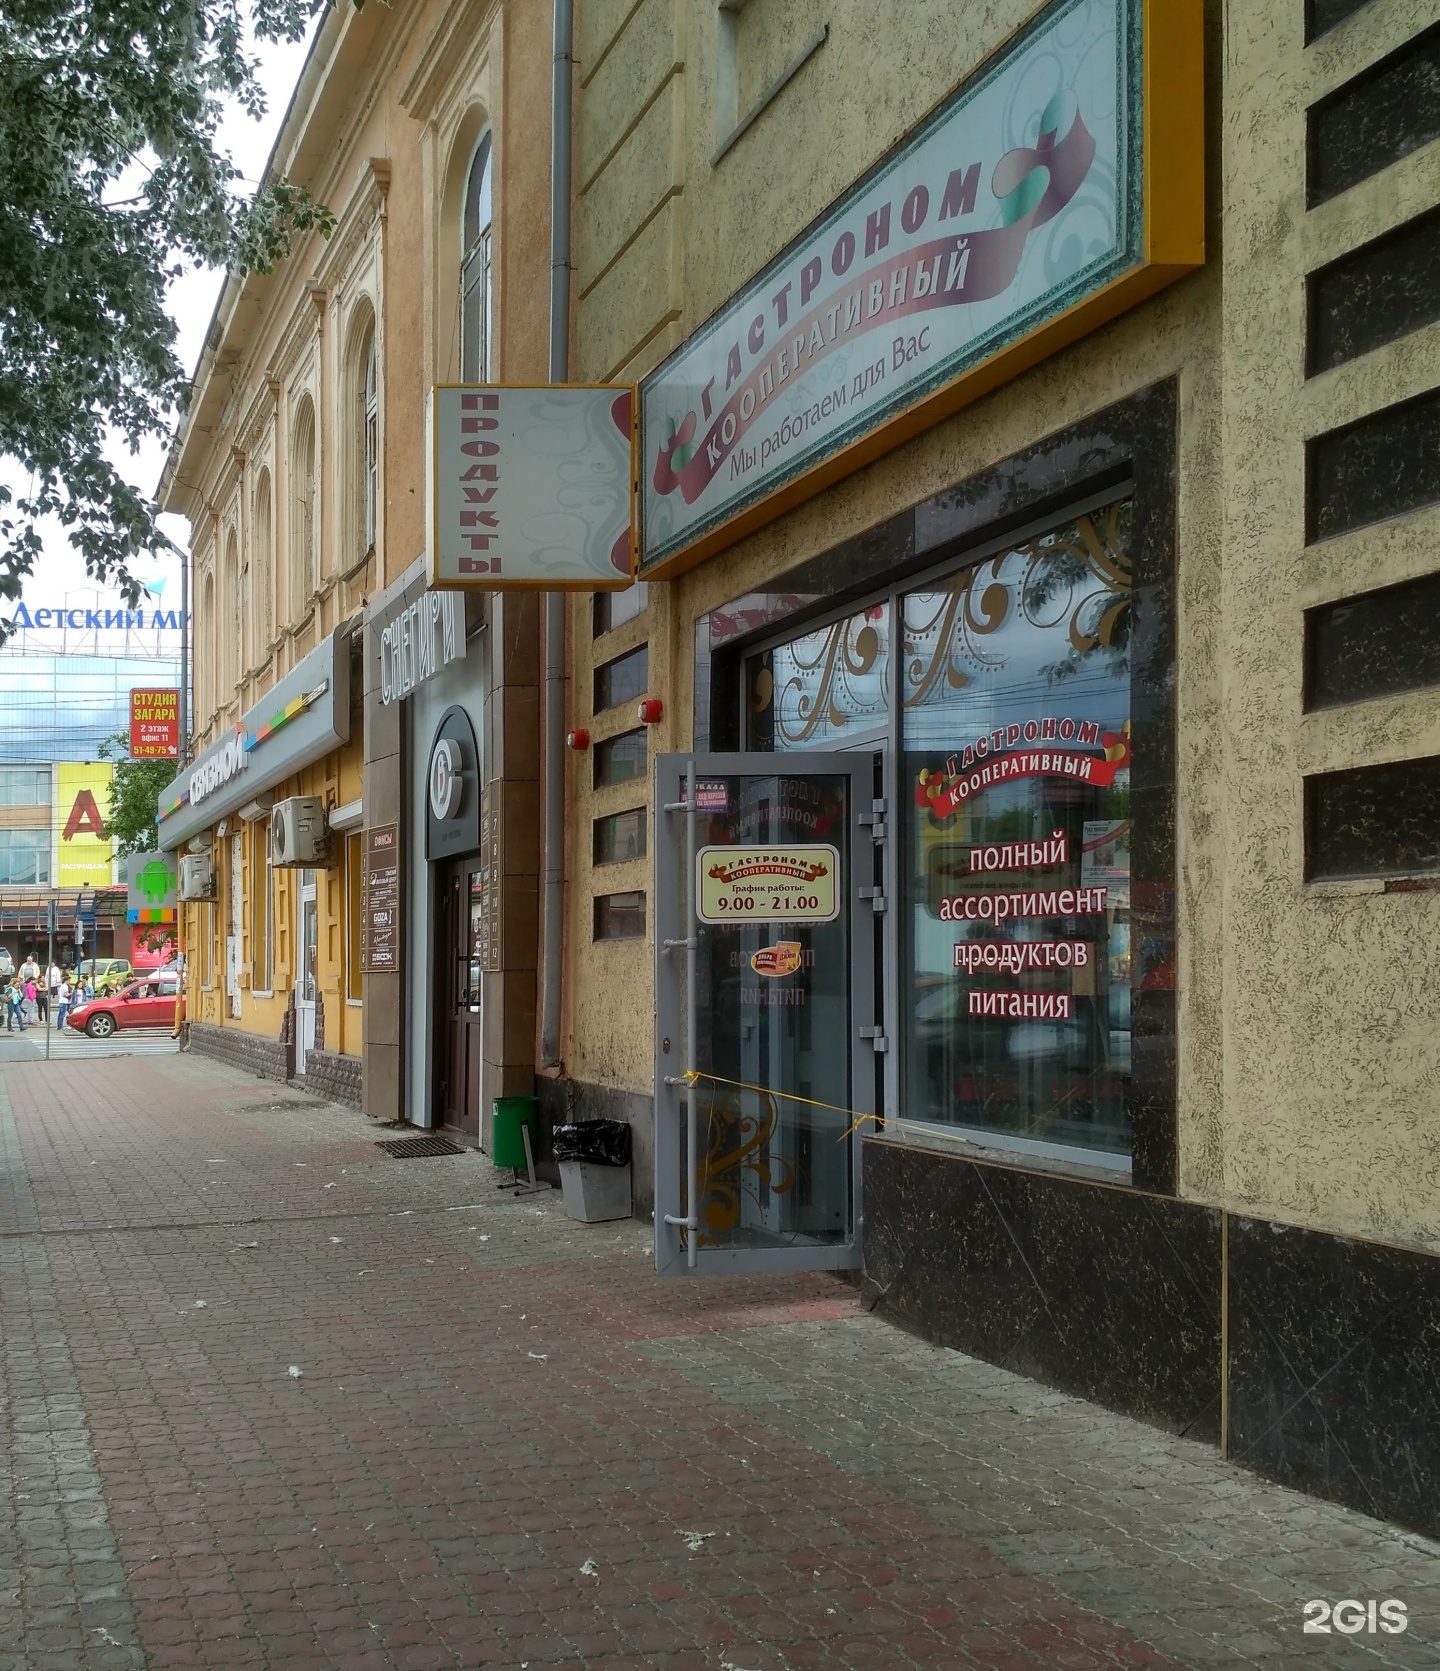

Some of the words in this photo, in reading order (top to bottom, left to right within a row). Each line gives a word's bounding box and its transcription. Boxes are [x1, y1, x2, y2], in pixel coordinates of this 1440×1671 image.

[701, 162, 982, 421] ГАСТРОНОМ
[706, 238, 971, 469] КООПЕРАТИВНЫЙ
[730, 448, 757, 481] Мы
[761, 385, 847, 468] работаем
[850, 357, 886, 405] для
[892, 326, 931, 372] Вас
[458, 394, 502, 573] ПРОДУКТЫ
[381, 590, 462, 706] СНЕГИРИ
[133, 693, 177, 707] СТУДИЯ
[134, 708, 176, 721] ЗАГАРА
[140, 724, 146, 733] 2
[148, 725, 169, 733] этаж
[141, 734, 160, 743] офис
[162, 734, 169, 742] 11
[133, 745, 167, 755] 51-49-75
[190, 722, 246, 806] СВЯЗНОЙ
[946, 717, 1100, 779] ГАСТРОНОМ
[950, 754, 1092, 807] КООПЕРАТИВНЫЙ
[728, 856, 808, 870] ГАСТРОНОМ
[970, 830, 1066, 871] полный
[731, 866, 806, 880] КООПЕРАТИВНЫЙ
[732, 884, 766, 894] График
[767, 884, 805, 894] работы:
[718, 897, 755, 911] 9.00
[771, 896, 819, 910] 21.00
[939, 887, 1107, 926] ассортимент
[953, 941, 1088, 975] продуктов
[968, 991, 1070, 1019] питания
